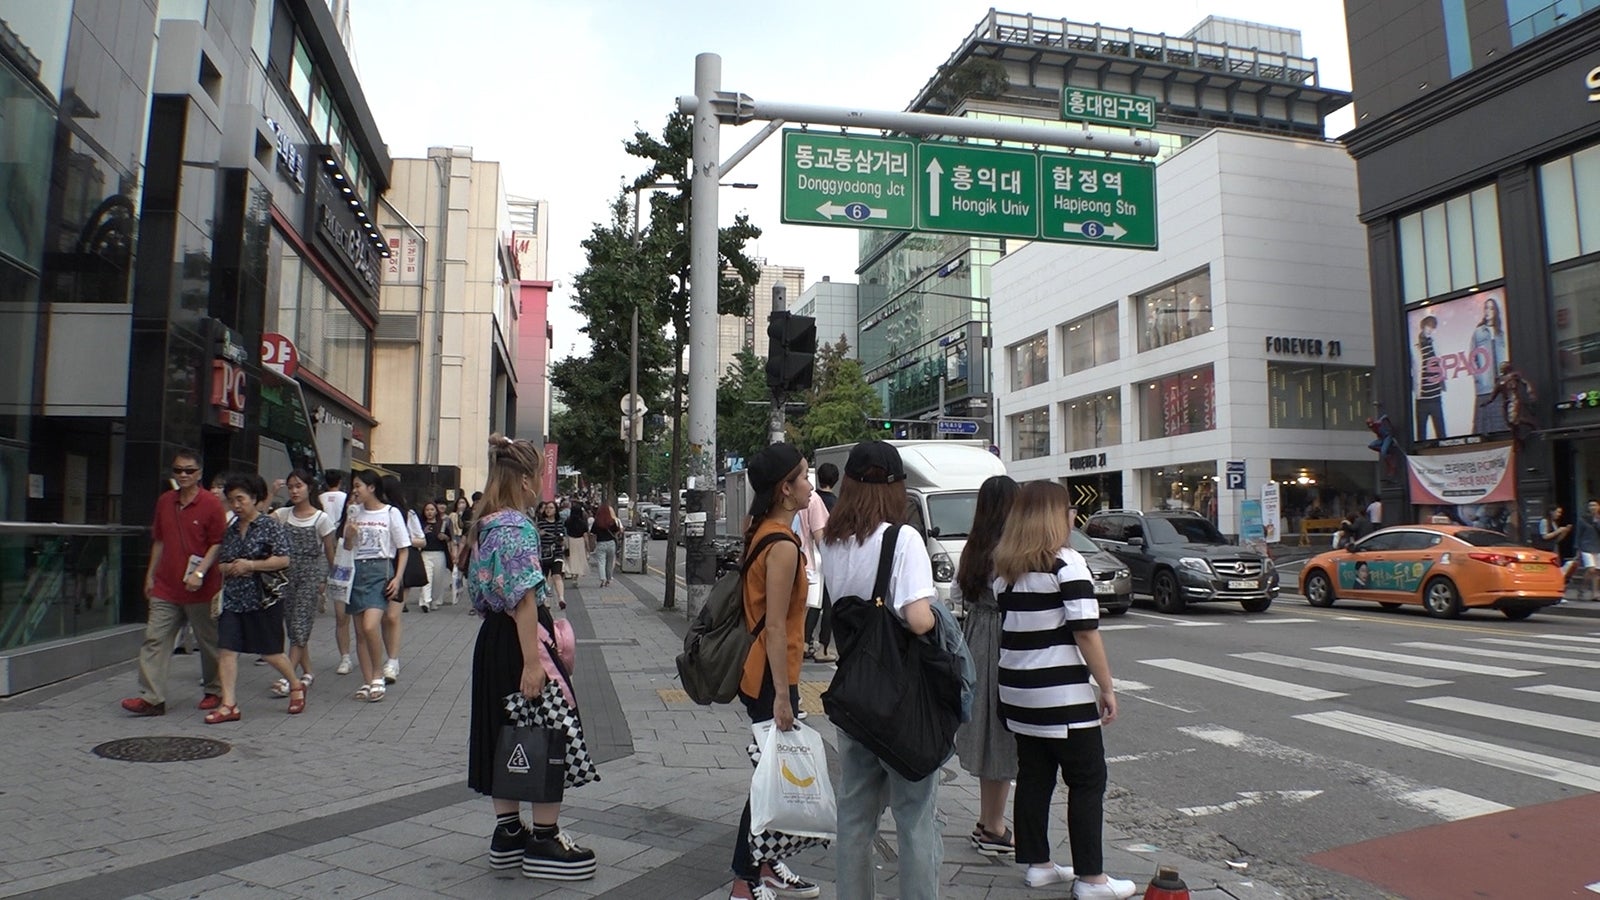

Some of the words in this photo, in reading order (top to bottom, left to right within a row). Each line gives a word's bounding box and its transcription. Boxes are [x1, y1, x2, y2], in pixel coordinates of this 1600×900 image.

[1068, 91, 1152, 123] 홍대입구역
[795, 144, 908, 177] 동교동삼거리
[798, 174, 881, 198] Donggyodong
[887, 181, 905, 196] Jct
[950, 165, 1021, 194] 홍익대
[1052, 166, 1122, 196] 합정역
[852, 205, 862, 218] 6
[952, 195, 997, 216] Hongik
[1001, 199, 1030, 216] Univ
[1053, 195, 1111, 217] Hapjeong
[1116, 199, 1136, 216] Stn
[1088, 223, 1097, 236] 6
[1265, 335, 1323, 355] FOREVER
[1328, 340, 1341, 356] 21
[1427, 347, 1492, 384] SPAO
[222, 364, 247, 411] PC
[1069, 454, 1097, 470] FOREVER
[1098, 453, 1106, 466] 21
[1230, 474, 1241, 488] P
